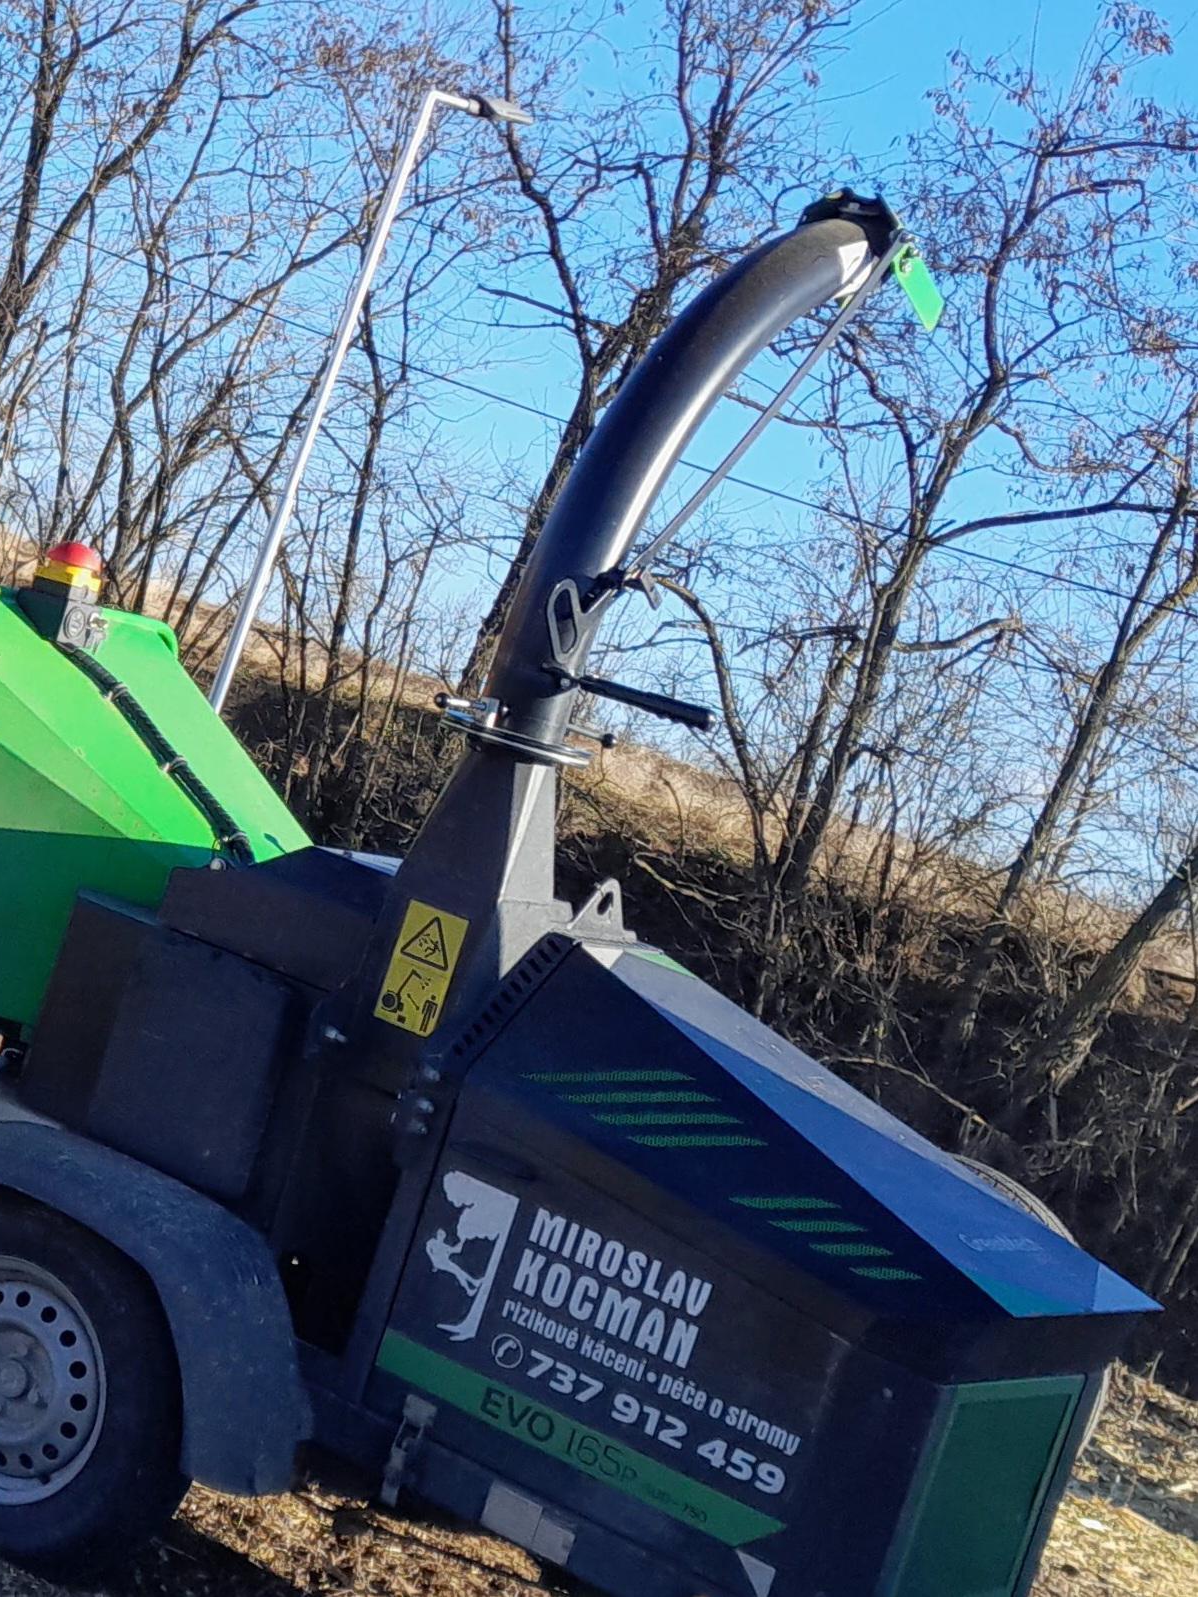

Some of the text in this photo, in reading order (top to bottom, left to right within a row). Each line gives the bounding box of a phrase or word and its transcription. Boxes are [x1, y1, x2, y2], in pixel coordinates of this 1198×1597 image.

[512, 1248, 700, 1369] KOCMAN
[528, 1207, 713, 1317] MIROSLAV
[479, 1386, 555, 1443] EVO
[526, 1349, 786, 1495] 737 912 459
[657, 1373, 707, 1411] péče
[708, 1398, 724, 1419] o
[724, 1405, 801, 1456] stromy
